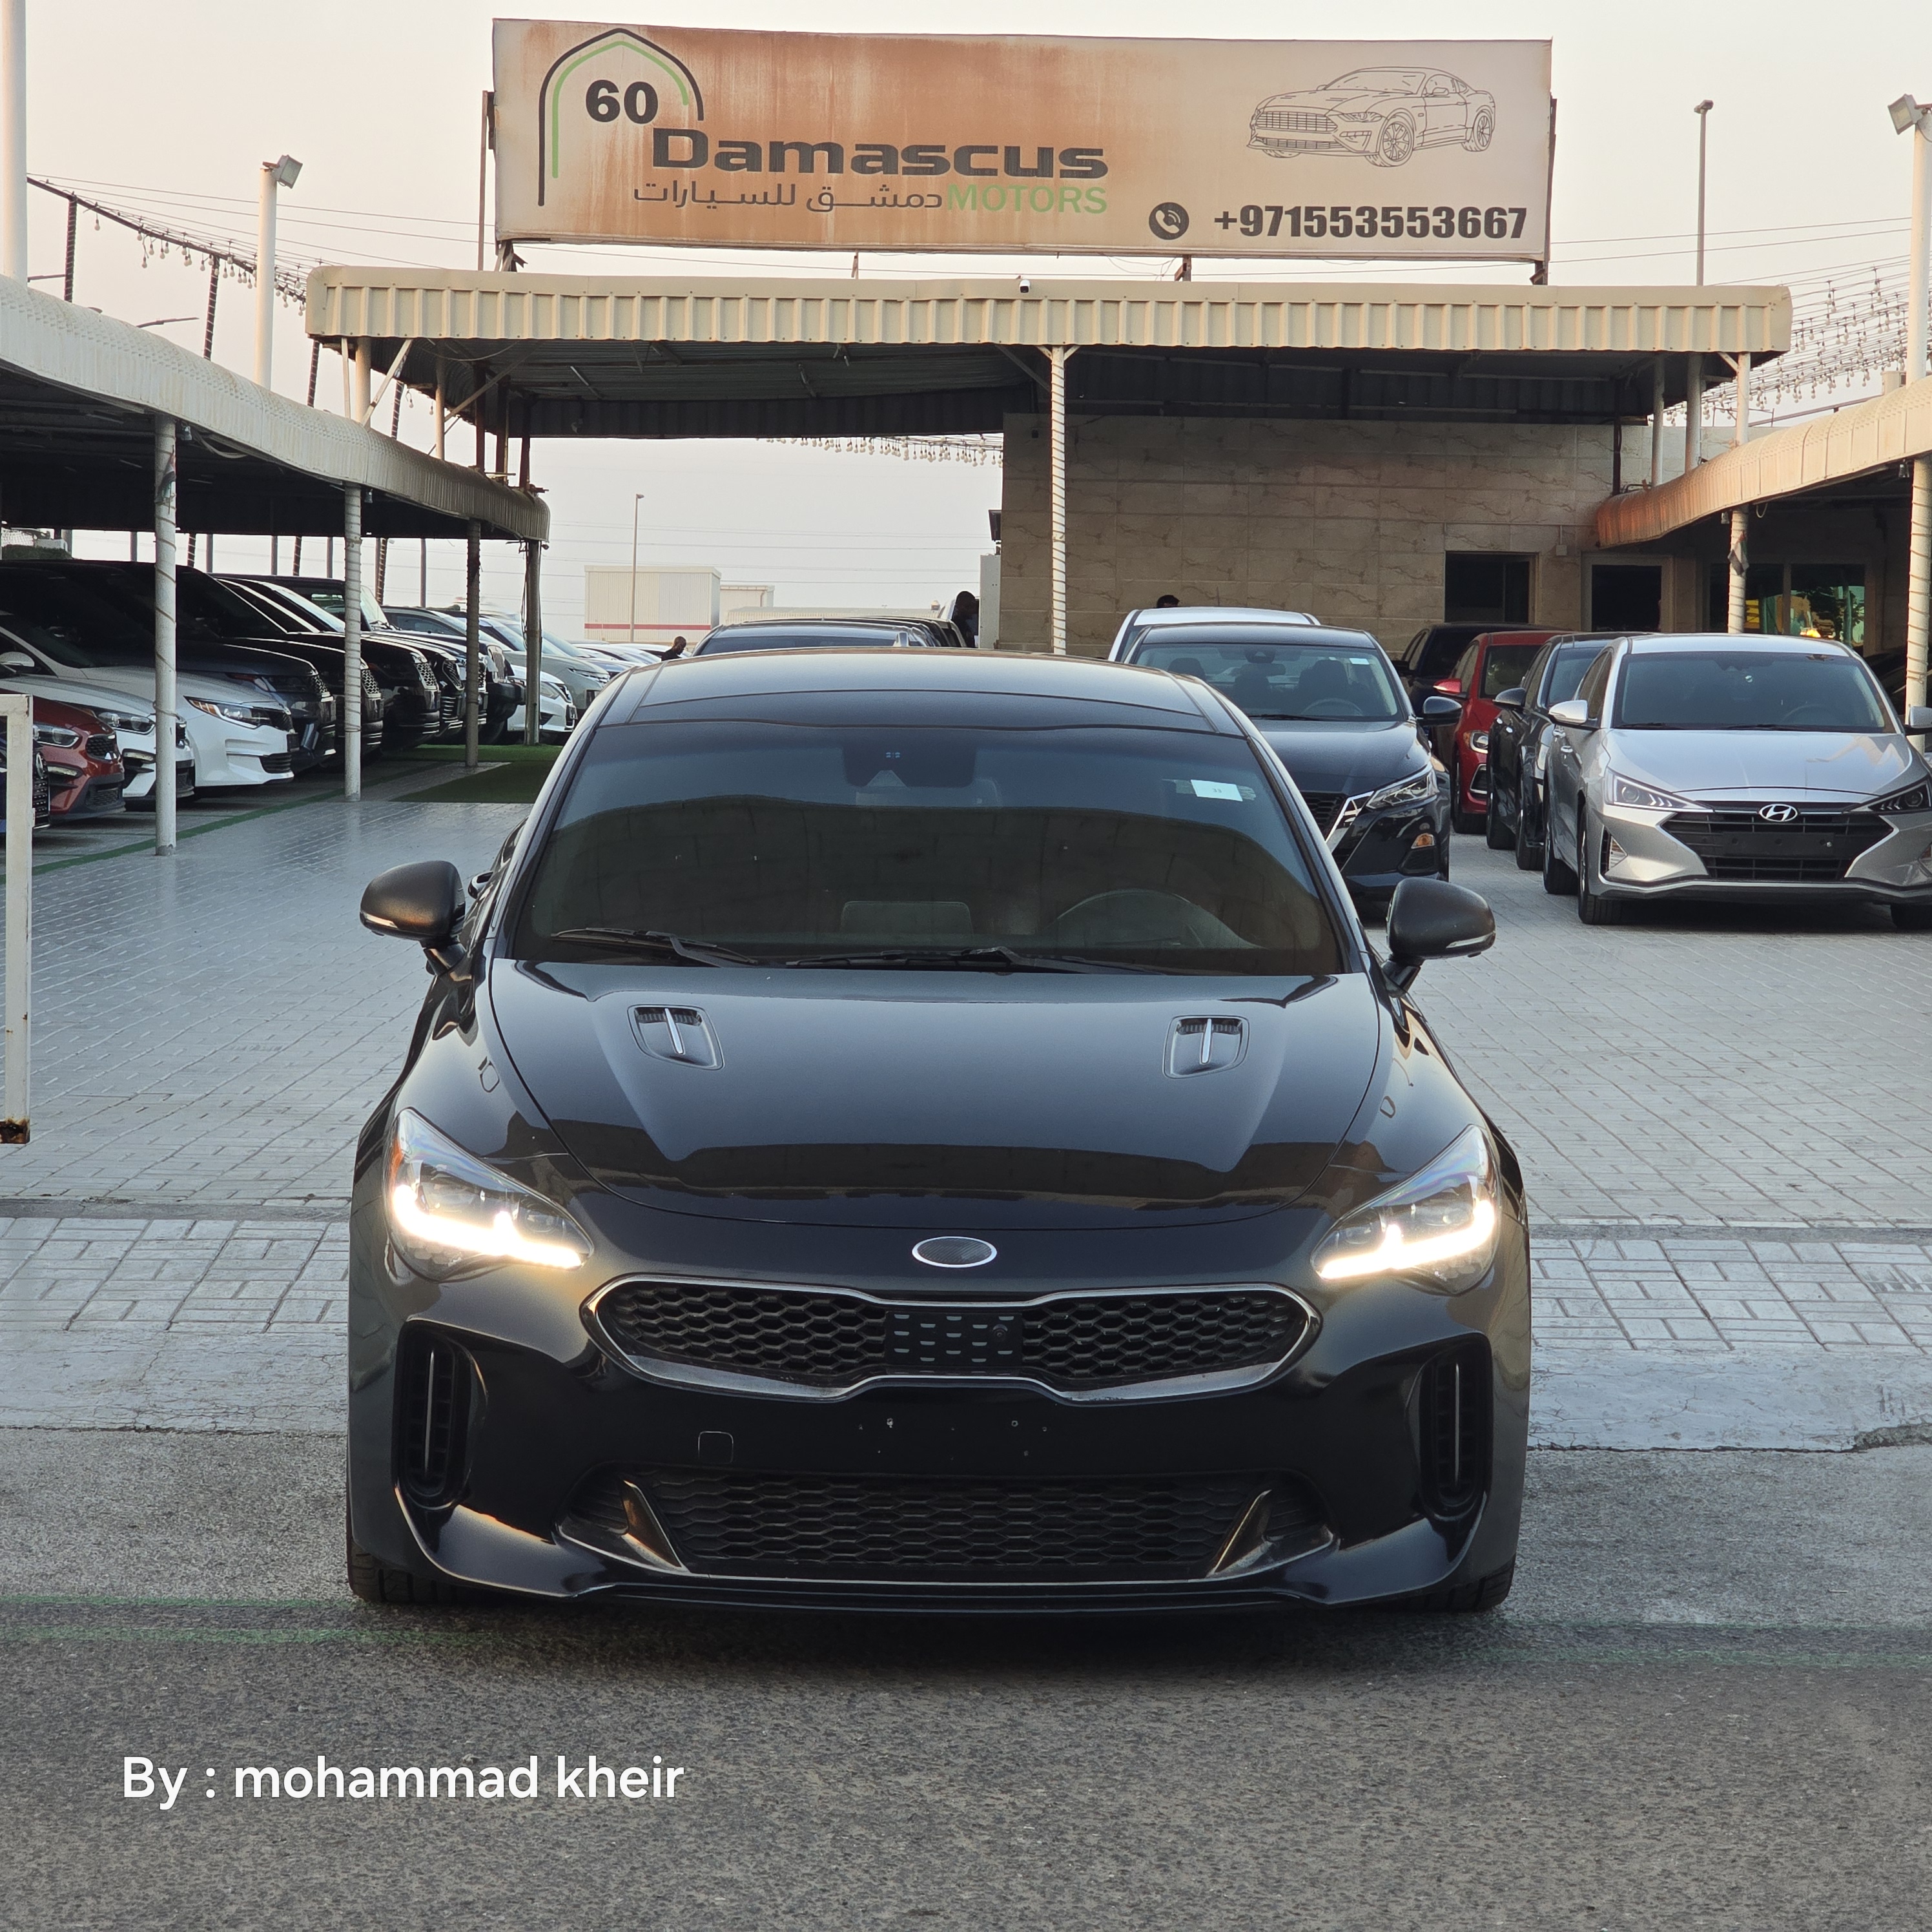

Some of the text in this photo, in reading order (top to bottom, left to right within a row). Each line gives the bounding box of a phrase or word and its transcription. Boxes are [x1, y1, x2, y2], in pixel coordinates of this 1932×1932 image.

[586, 79, 659, 124] 60
[653, 127, 1109, 179] Damascus
[633, 180, 943, 212] دمشق للسيارات
[947, 184, 1107, 214] MOTORS
[1214, 205, 1527, 239] +971553553667
